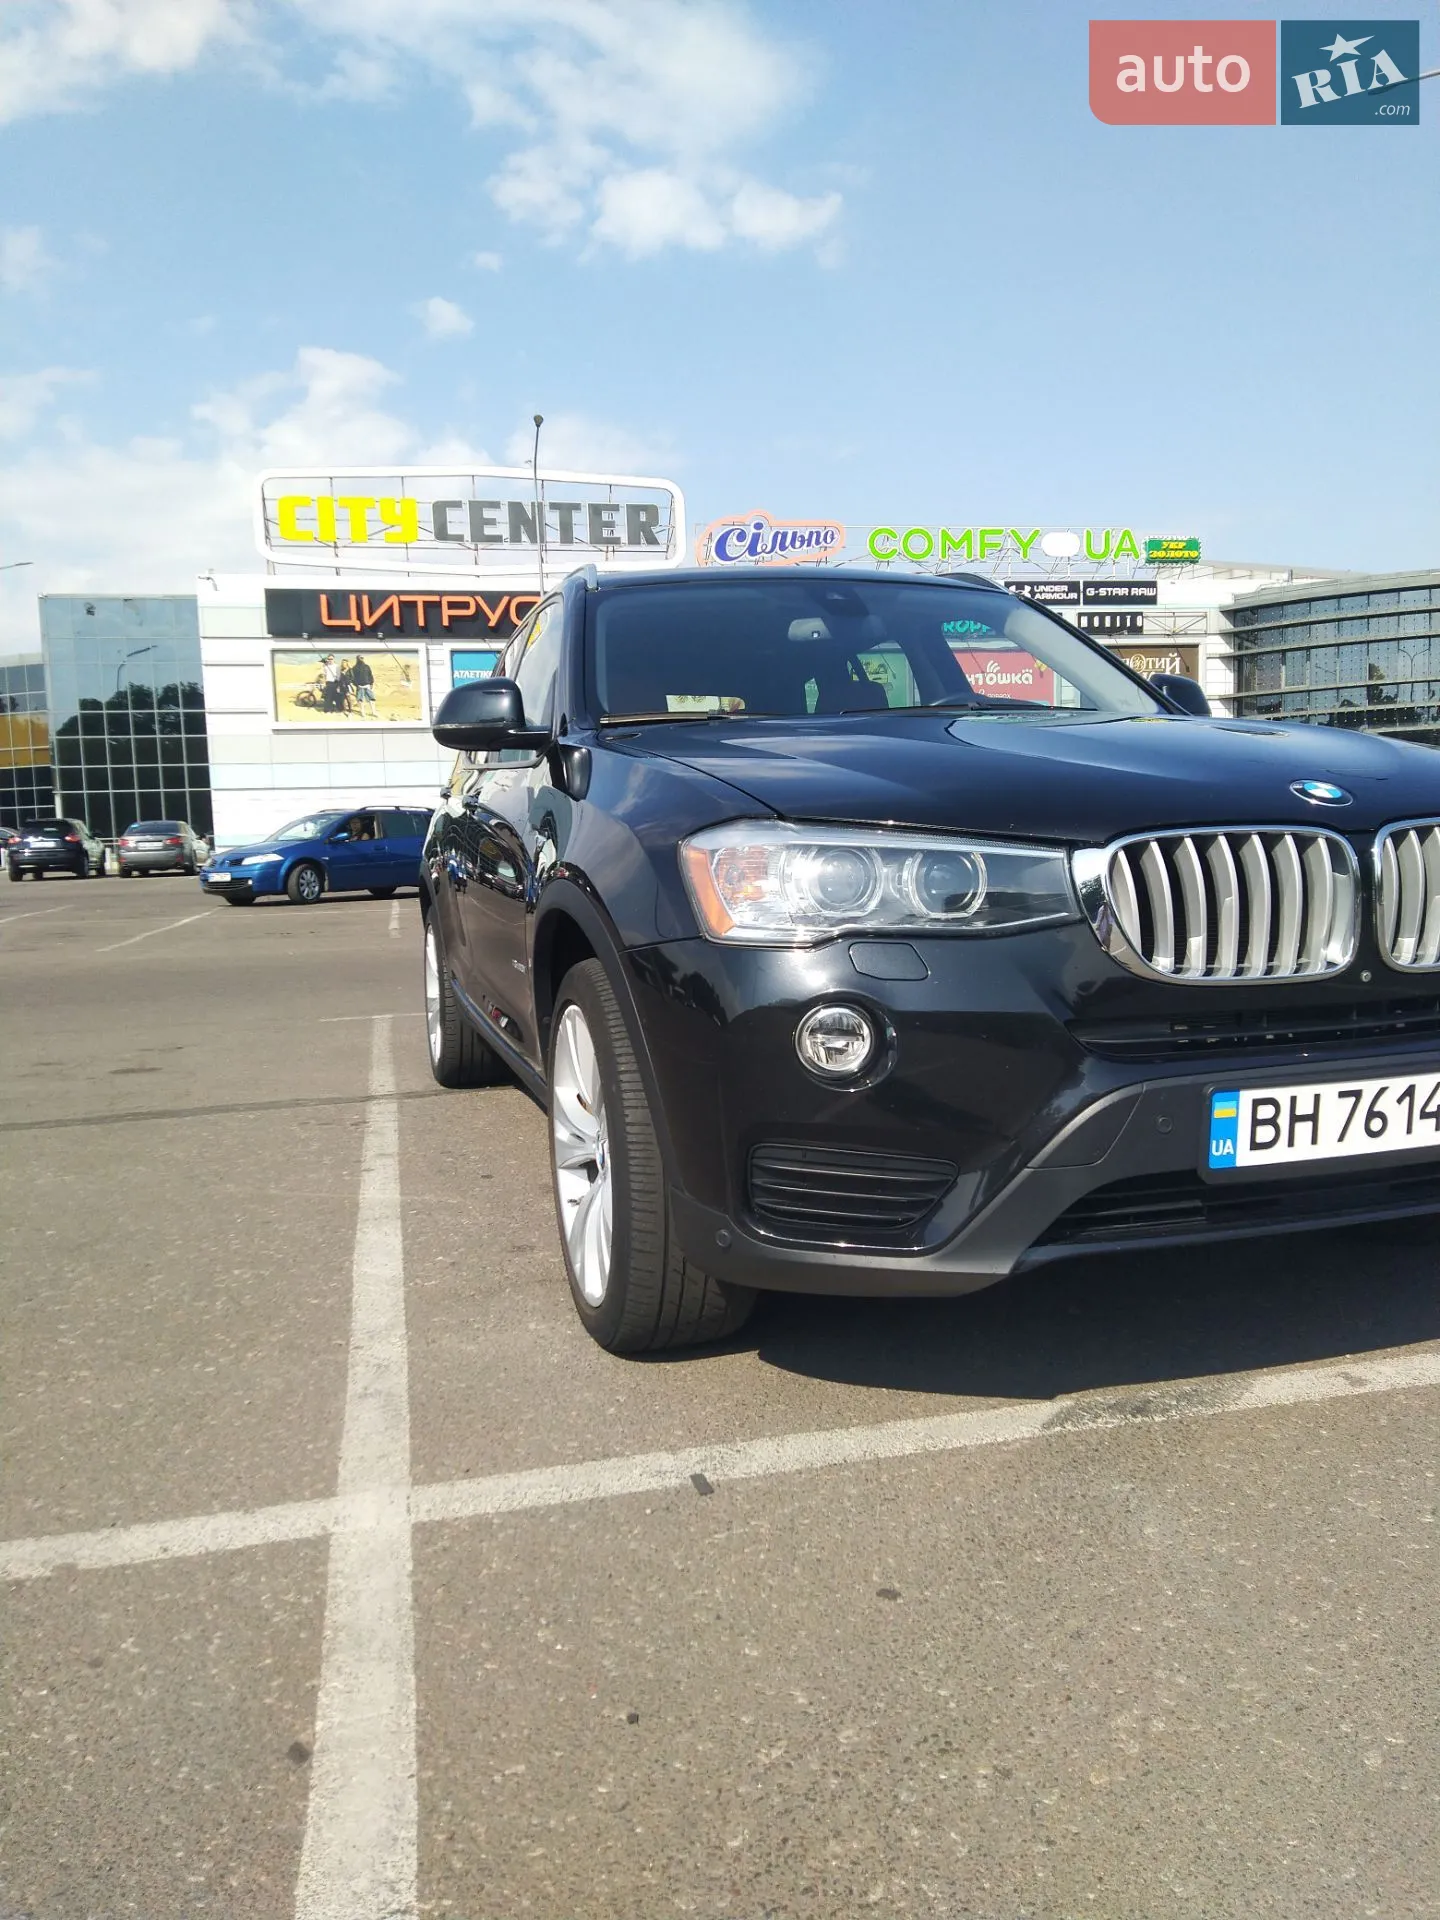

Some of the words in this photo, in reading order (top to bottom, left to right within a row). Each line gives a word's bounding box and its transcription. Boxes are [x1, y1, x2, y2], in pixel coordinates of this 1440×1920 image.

[278, 496, 418, 543] CITY
[432, 499, 660, 545] CENTER
[714, 522, 835, 562] Сільпо
[868, 527, 1041, 561] COMFY
[1085, 528, 1140, 561] UA
[1034, 585, 1068, 593] UNDER
[1034, 592, 1078, 600] ARMOUR
[1086, 587, 1129, 597] G-STAR
[1131, 587, 1157, 596] RAW
[1249, 1093, 1321, 1151] BH
[1337, 1081, 1440, 1143] 7614
[1211, 1138, 1235, 1156] UA
